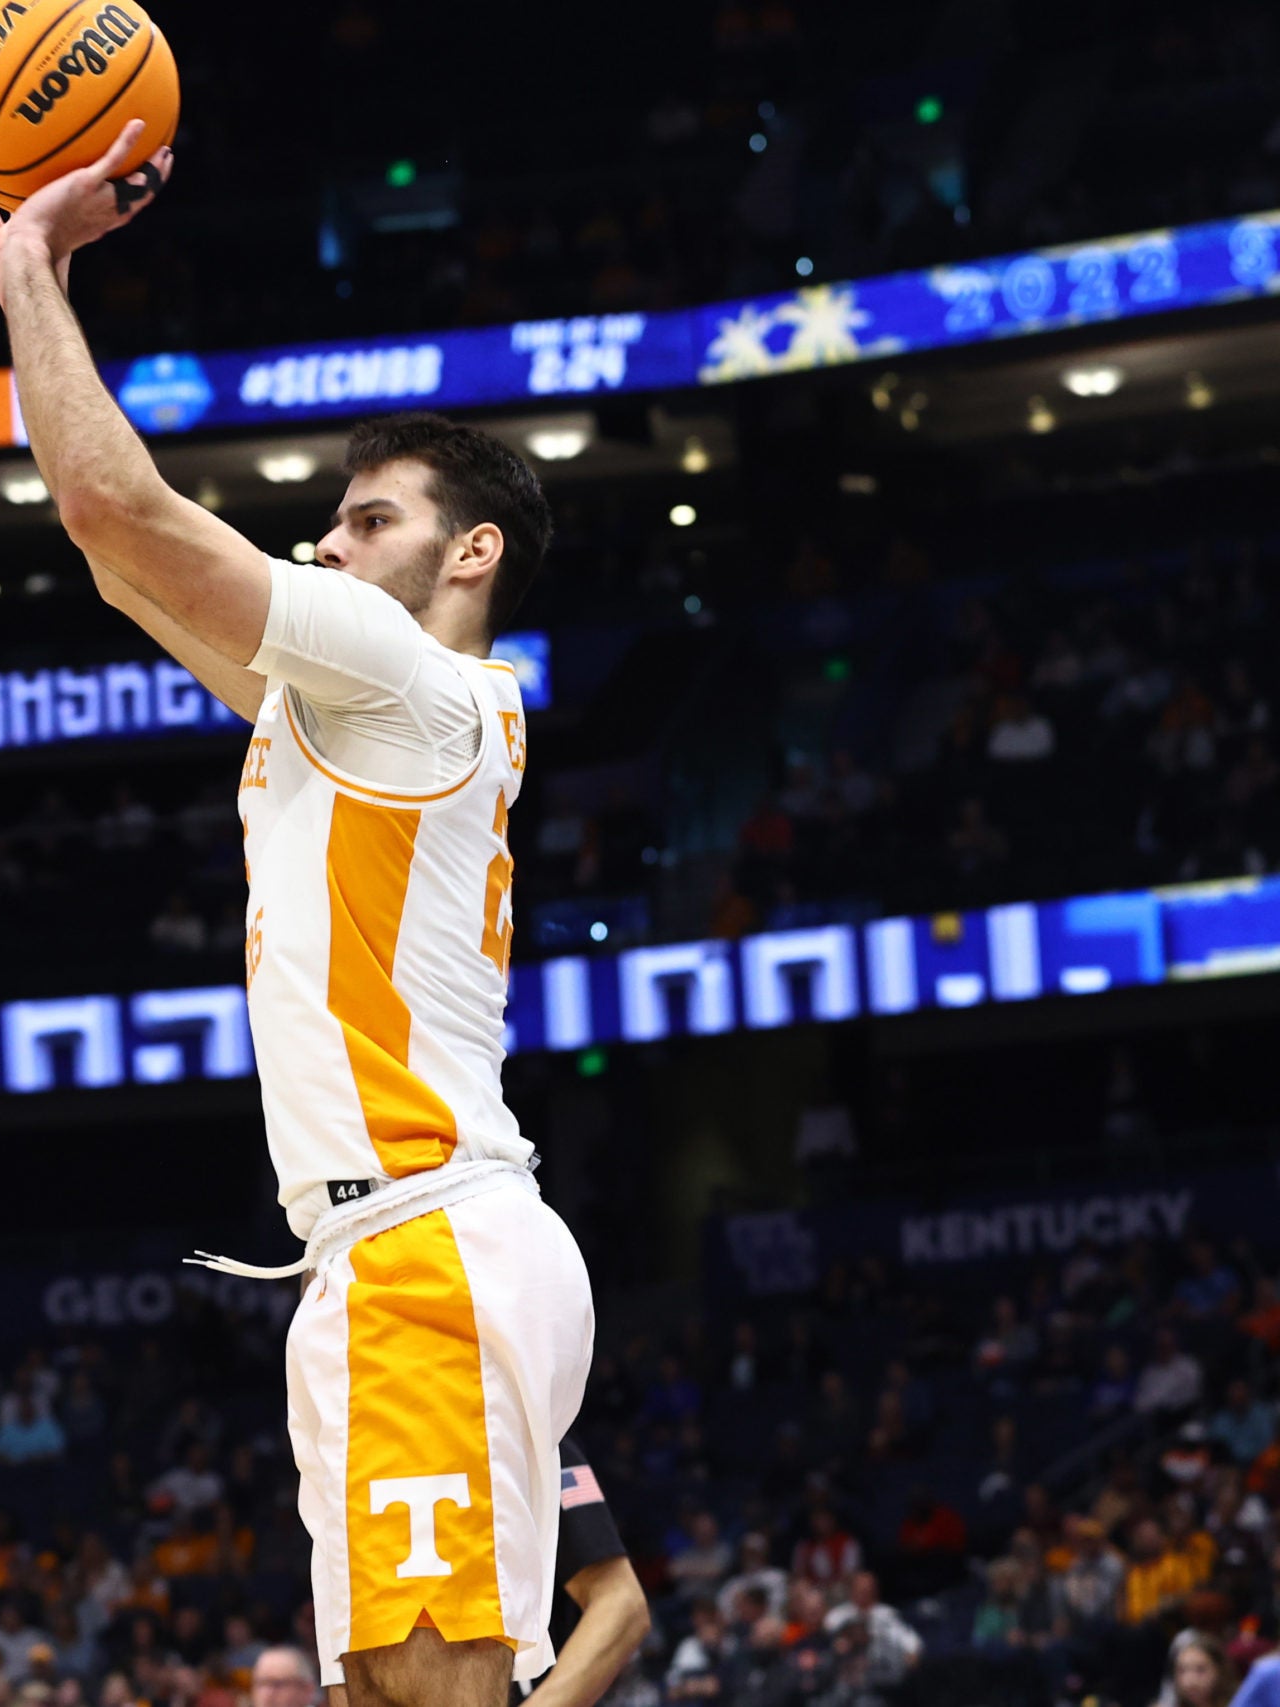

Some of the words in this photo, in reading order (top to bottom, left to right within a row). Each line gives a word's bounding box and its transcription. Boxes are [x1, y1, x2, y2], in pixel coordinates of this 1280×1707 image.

[17, 4, 140, 125] Wilson
[941, 238, 1183, 334] 2022
[336, 1182, 360, 1200] 44
[899, 1187, 1195, 1265] KENTUCKY
[369, 1472, 472, 1579] T
